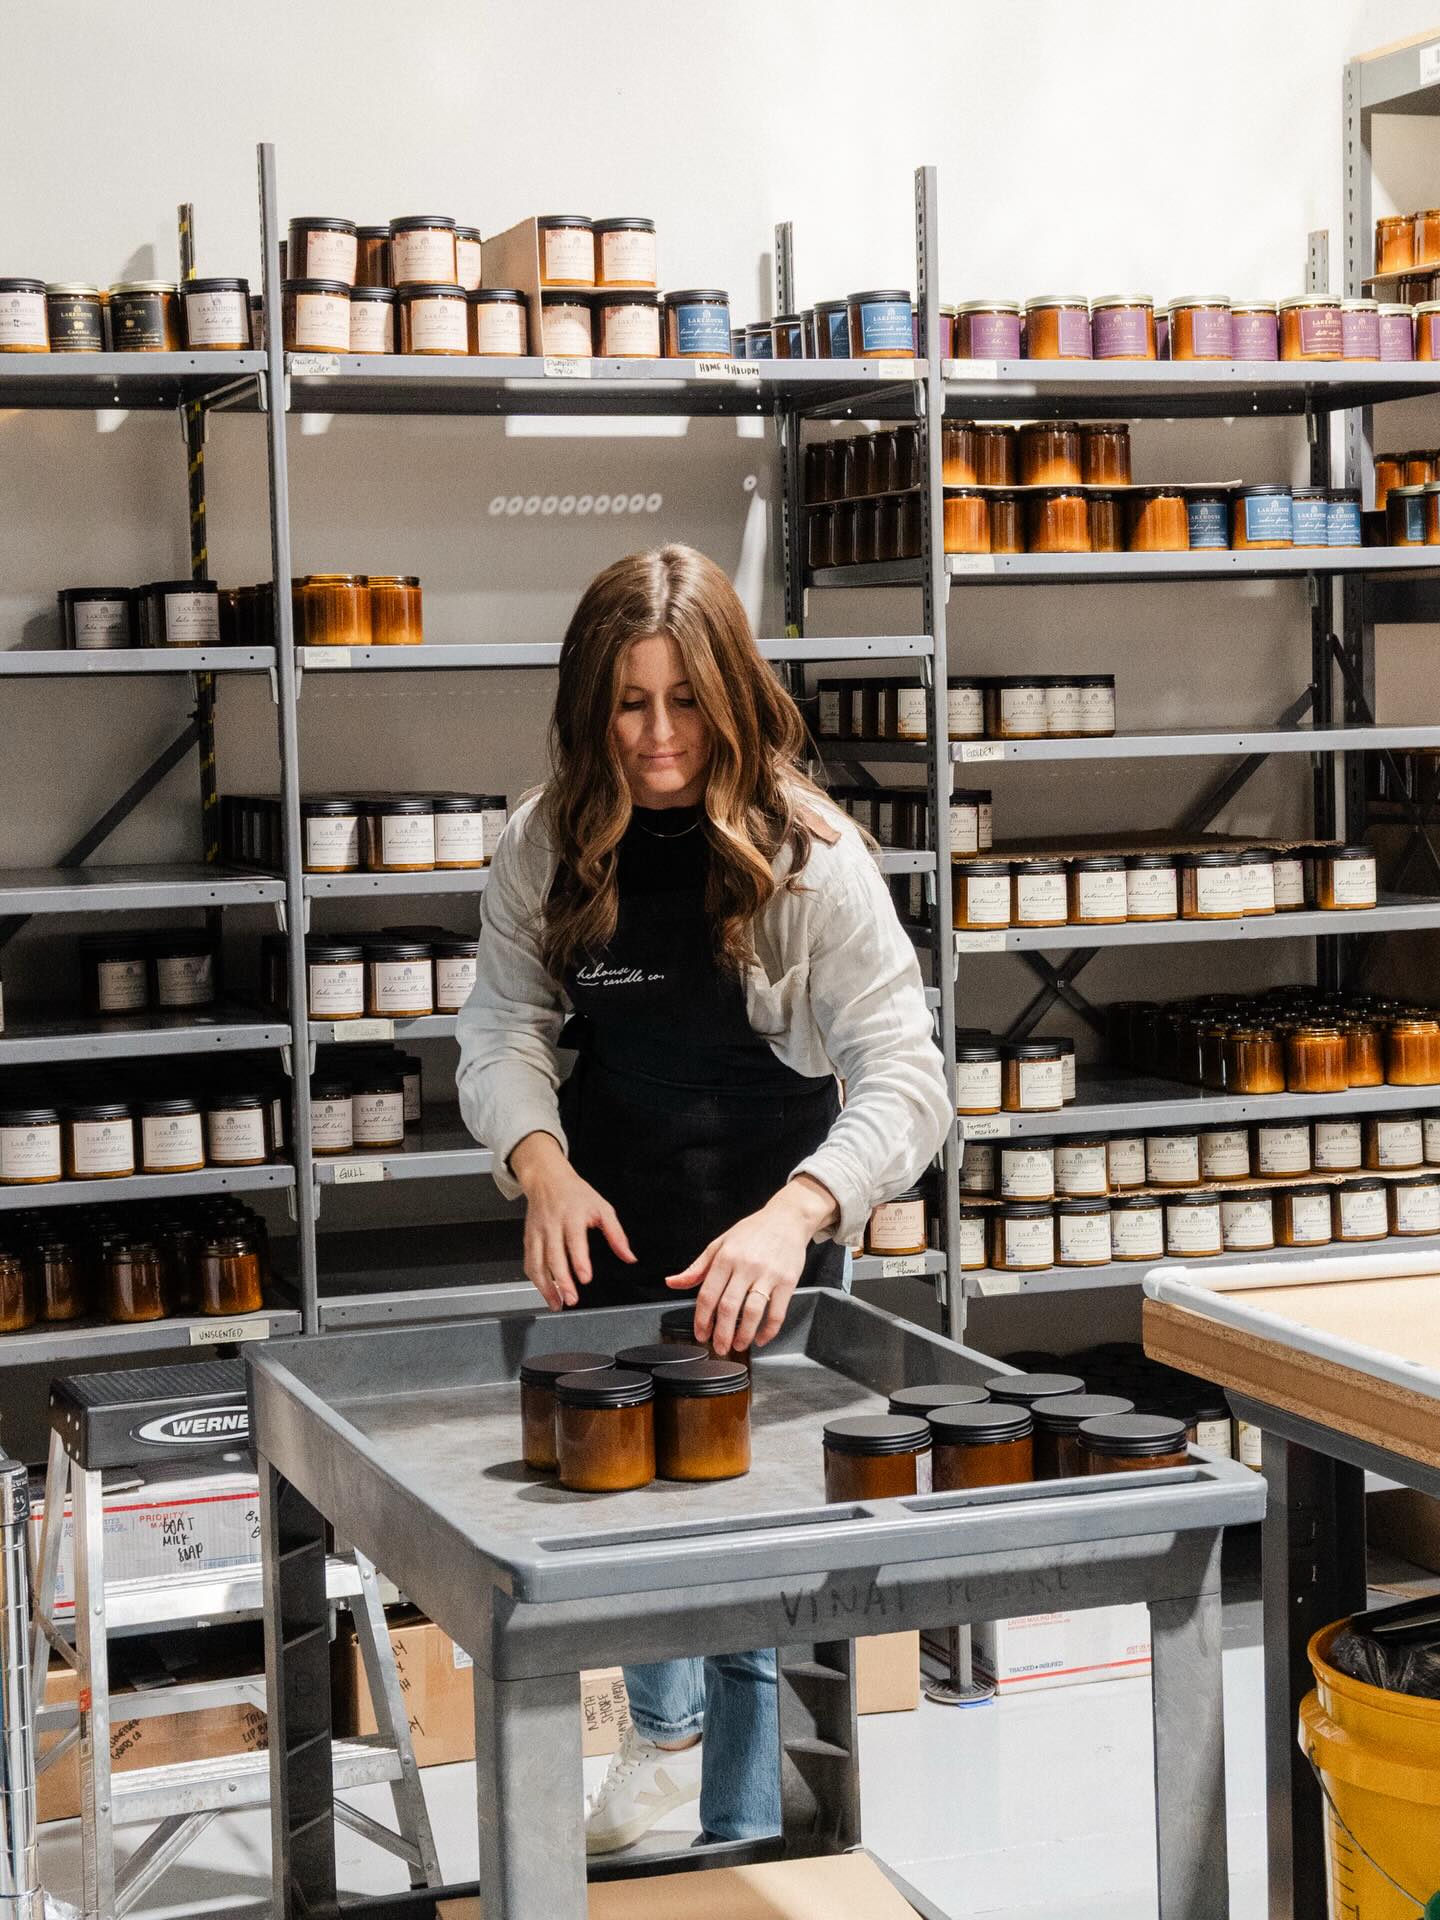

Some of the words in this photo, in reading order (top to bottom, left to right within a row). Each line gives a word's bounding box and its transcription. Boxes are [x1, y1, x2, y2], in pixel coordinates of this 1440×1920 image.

[699, 362, 721, 373] HOME
[603, 968, 645, 986] candle
[339, 1167, 366, 1180] GULL
[198, 1327, 244, 1341] UNSCENTED
[172, 1414, 249, 1436] WERNE
[139, 1511, 186, 1522] PRIORITY
[163, 1517, 196, 1534] GOAT
[162, 1534, 191, 1546] MILK
[177, 1542, 204, 1563] SOAP
[1009, 1663, 1035, 1674] TRACKED
[584, 1695, 599, 1731] NORTH
[597, 1693, 614, 1724] SHORE
